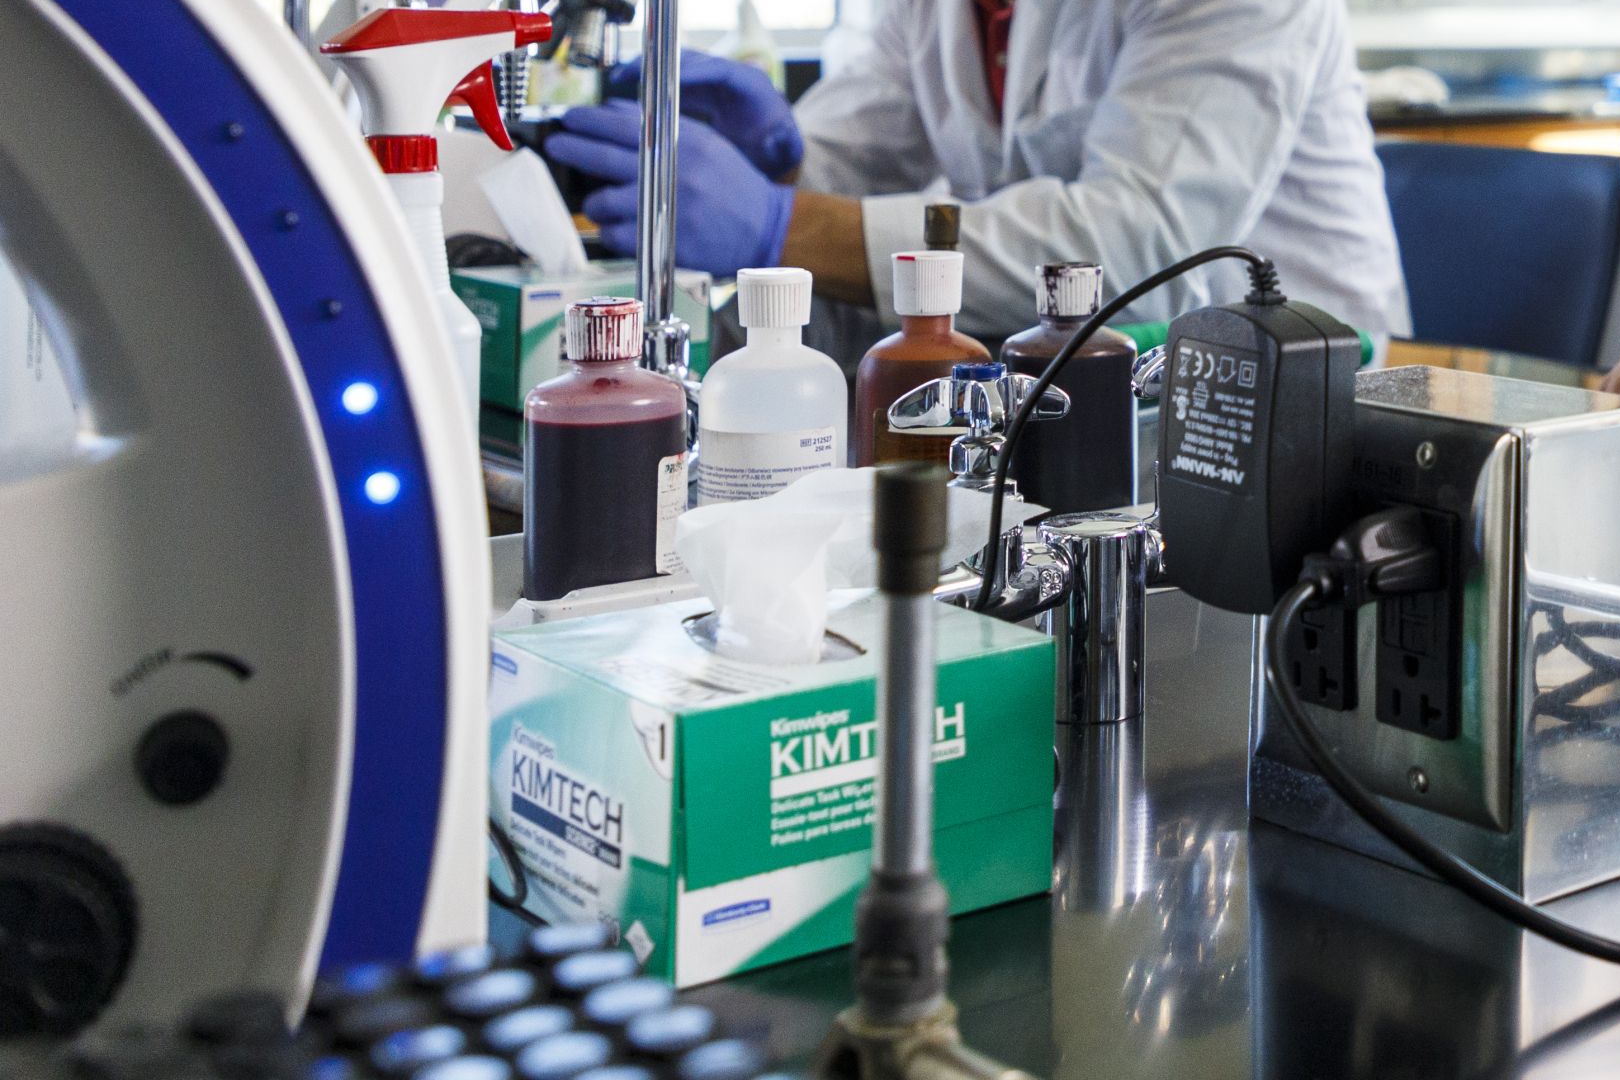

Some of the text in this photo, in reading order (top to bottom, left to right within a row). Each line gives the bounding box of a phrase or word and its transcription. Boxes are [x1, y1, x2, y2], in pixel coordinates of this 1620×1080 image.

[770, 709, 850, 738] Kimwipes
[770, 703, 965, 778] KIMTH
[511, 749, 624, 843] KIMTECH
